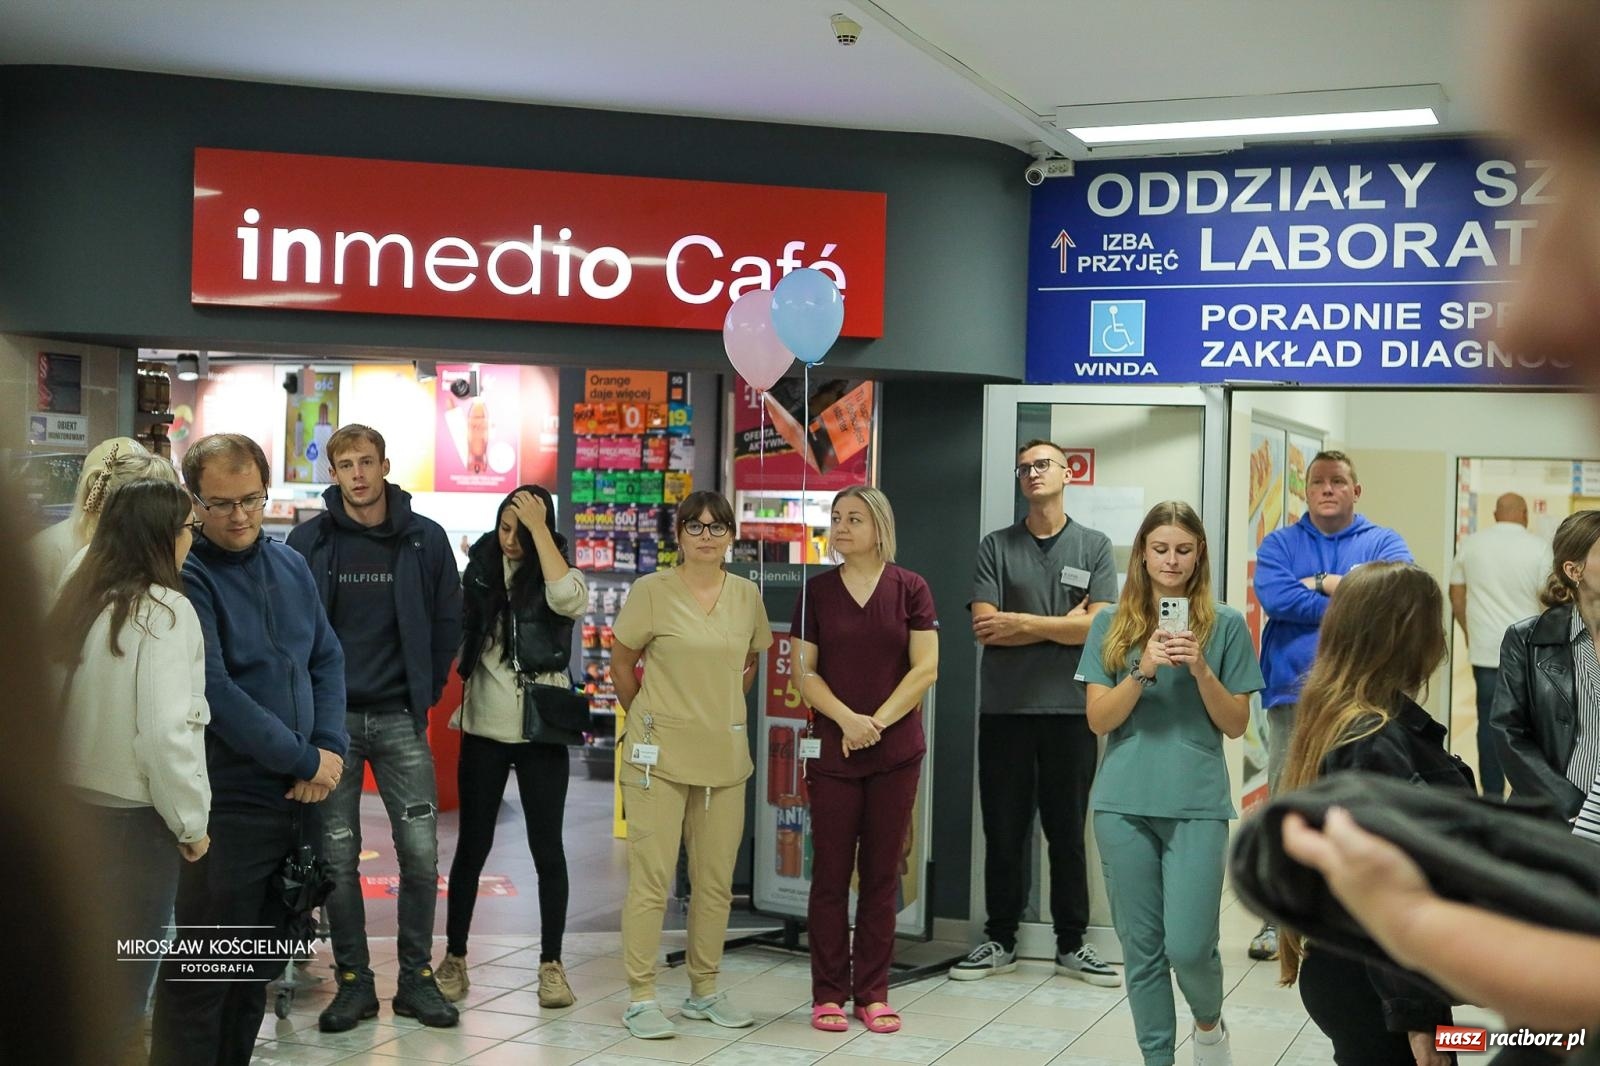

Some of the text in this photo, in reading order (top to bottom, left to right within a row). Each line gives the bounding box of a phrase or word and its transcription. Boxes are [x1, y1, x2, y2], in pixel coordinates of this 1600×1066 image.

[1086, 160, 1560, 217] ODDZIAŁY SZ
[1102, 233, 1154, 251] IZBA
[1201, 219, 1539, 271] LABORAT
[237, 208, 633, 299] inmedio
[1078, 248, 1179, 275] PRZYJĘĆ
[1201, 302, 1421, 331] PORADNIE
[1200, 340, 1362, 369] ZAKŁAD
[1074, 362, 1159, 376] WINDA
[590, 374, 630, 387] Orange
[590, 388, 651, 401] daje więcej
[338, 573, 394, 583] HILFIGER
[779, 639, 792, 656] D
